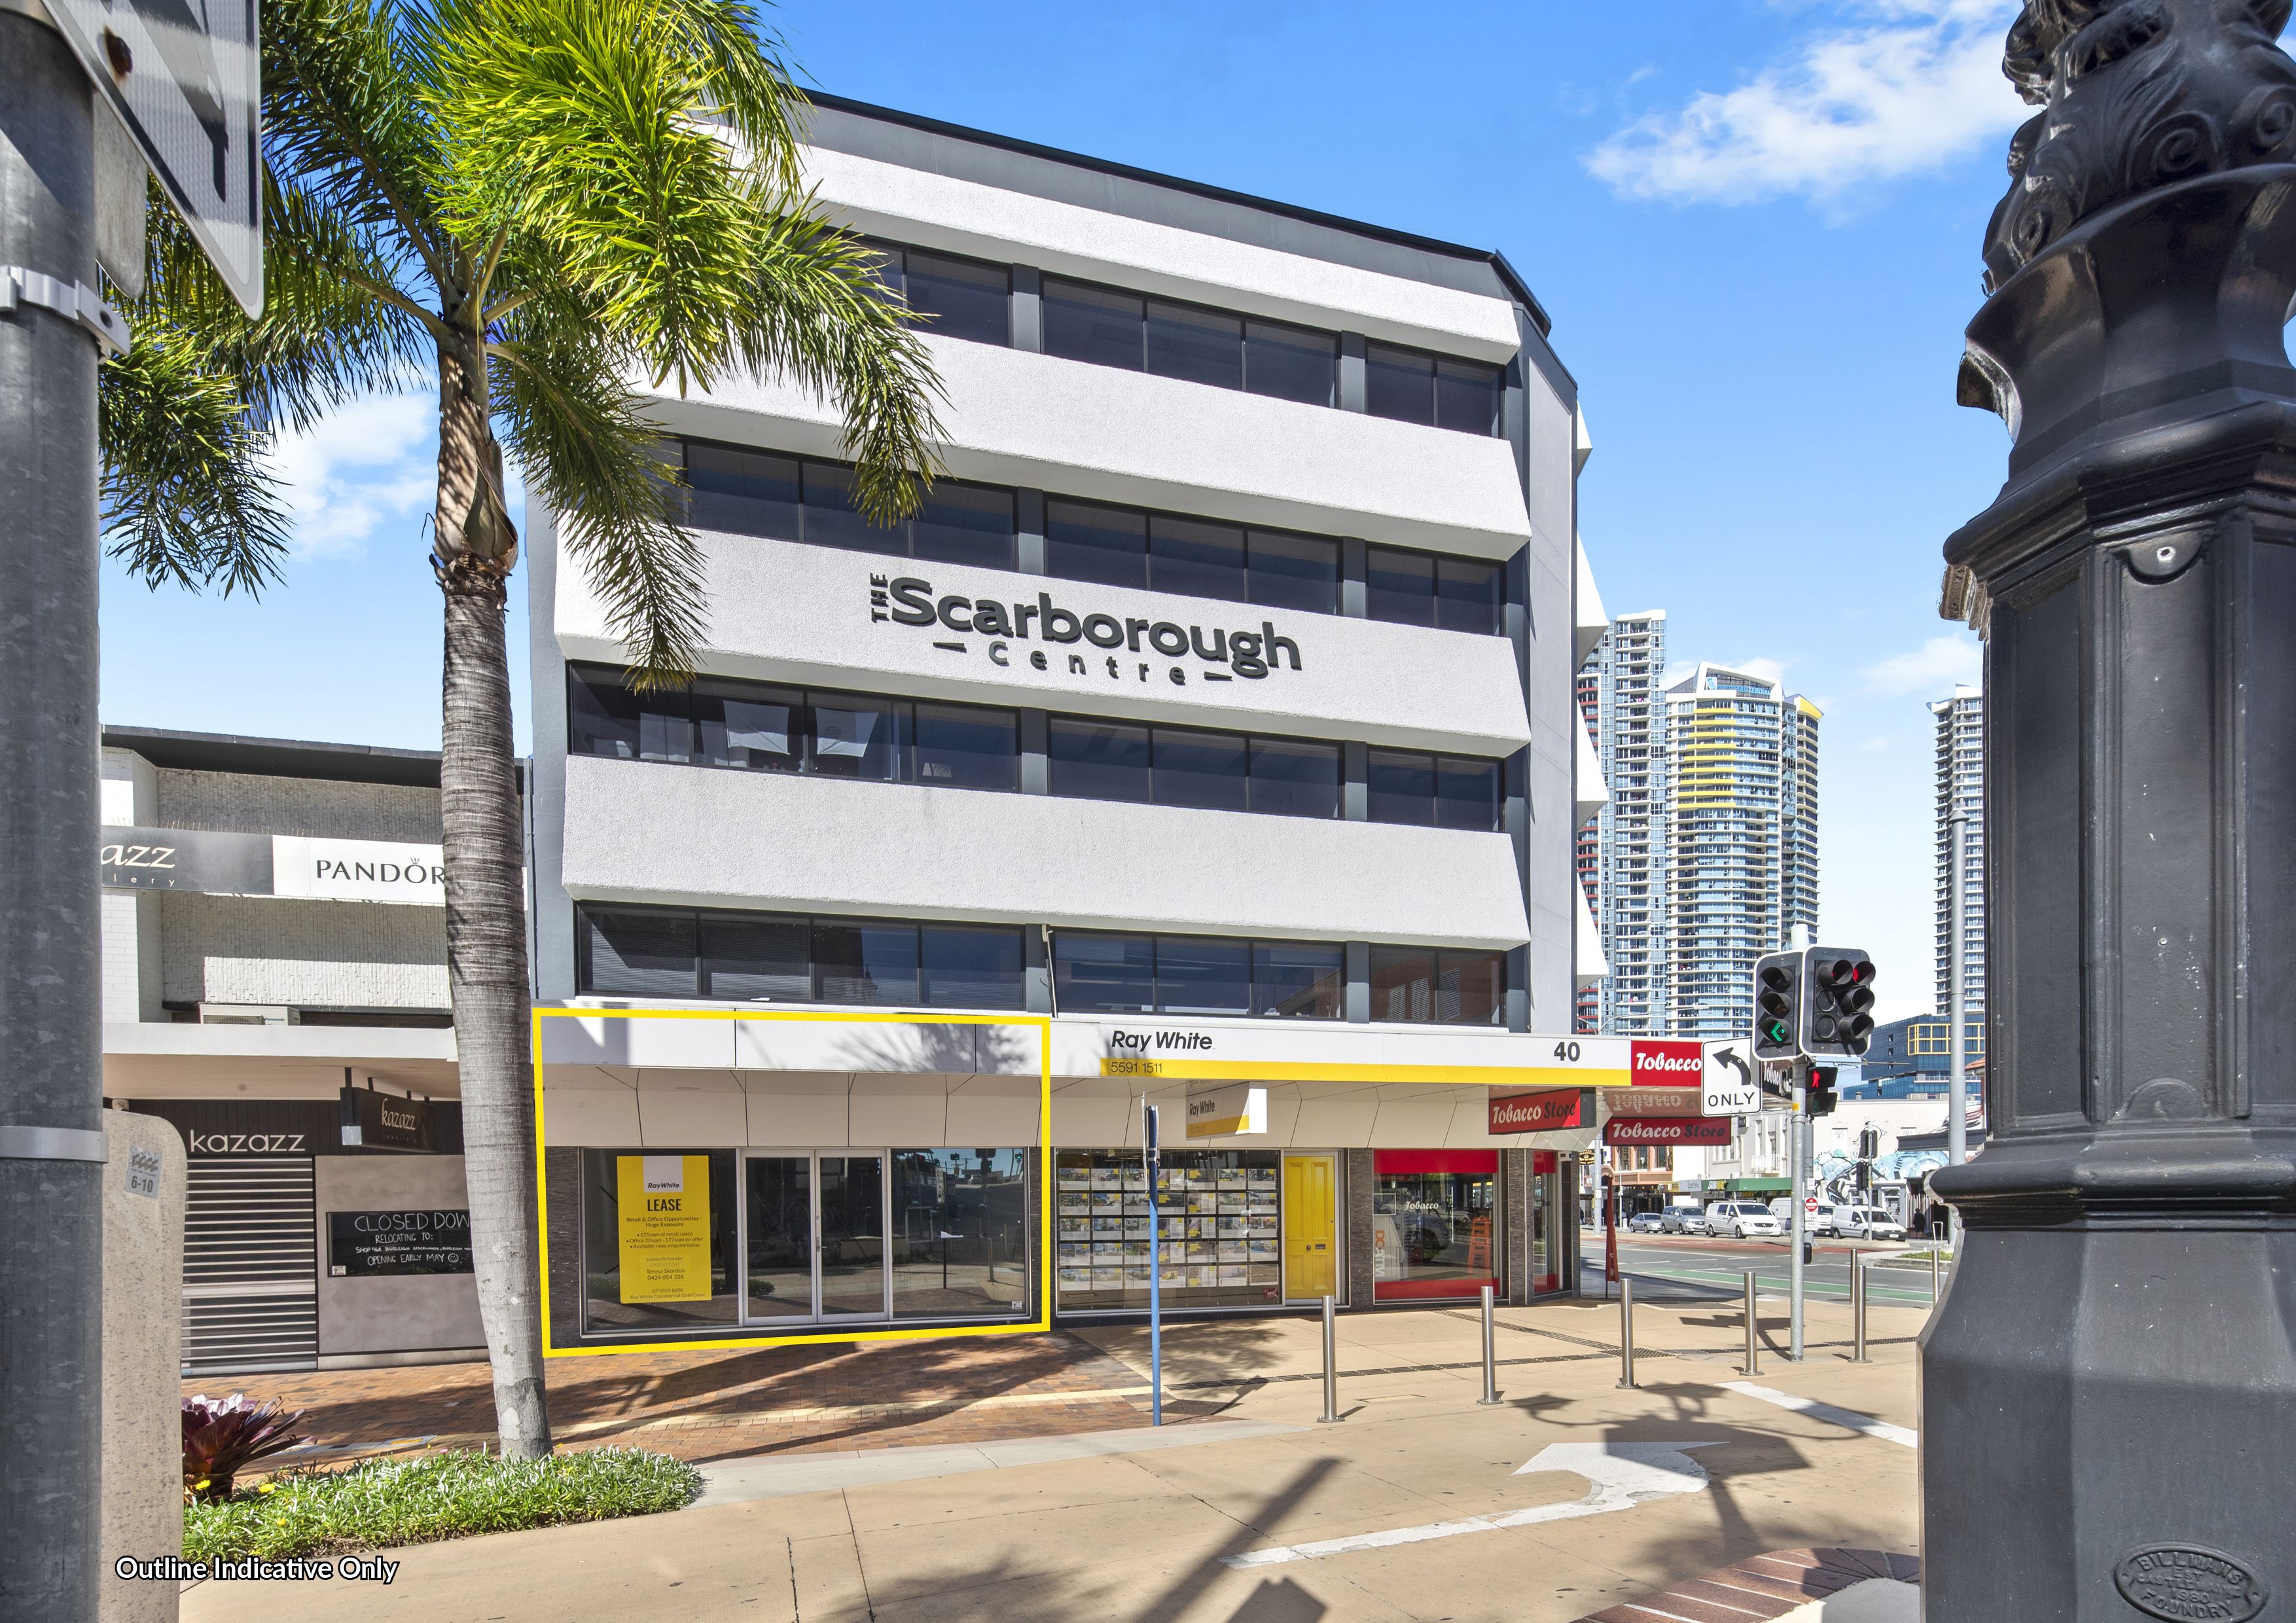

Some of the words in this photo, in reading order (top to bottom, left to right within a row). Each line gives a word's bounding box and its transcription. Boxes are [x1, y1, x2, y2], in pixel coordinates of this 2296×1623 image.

[870, 573, 889, 623] THE
[889, 577, 1302, 679] Scarborough
[988, 640, 1186, 685] Centre
[101, 844, 175, 868] azz
[317, 858, 444, 885] PANDOR
[1111, 1030, 1152, 1052] Ray
[1156, 1031, 1213, 1050] White
[1554, 1042, 1580, 1062] 40
[1636, 1052, 1701, 1071] Tobacco
[1111, 1061, 1138, 1073] 5591
[1142, 1062, 1162, 1073] 1511
[1189, 1103, 1199, 1117] Ray
[1200, 1099, 1215, 1115] White
[1708, 1092, 1755, 1107] ONLY
[382, 1098, 416, 1130] kazazz
[1493, 1103, 1541, 1124] Tobacco
[1543, 1101, 1576, 1120] Store
[1613, 1122, 1681, 1138] Tobacco
[1684, 1124, 1725, 1137] Store
[190, 1130, 306, 1152] kazazz
[131, 1175, 154, 1193] 6-10
[647, 1199, 681, 1211] LEASE
[1405, 1201, 1439, 1210] Tobacco
[355, 1213, 428, 1232] CLOSED
[435, 1212, 471, 1229] DOW
[375, 1233, 416, 1243] RELOCATING
[422, 1232, 433, 1241] TO:
[367, 1255, 395, 1266] OPENING
[426, 1253, 444, 1262] MAY
[2174, 1567, 2203, 1582] EST
[2140, 1588, 2234, 1619] FOUNDRY
